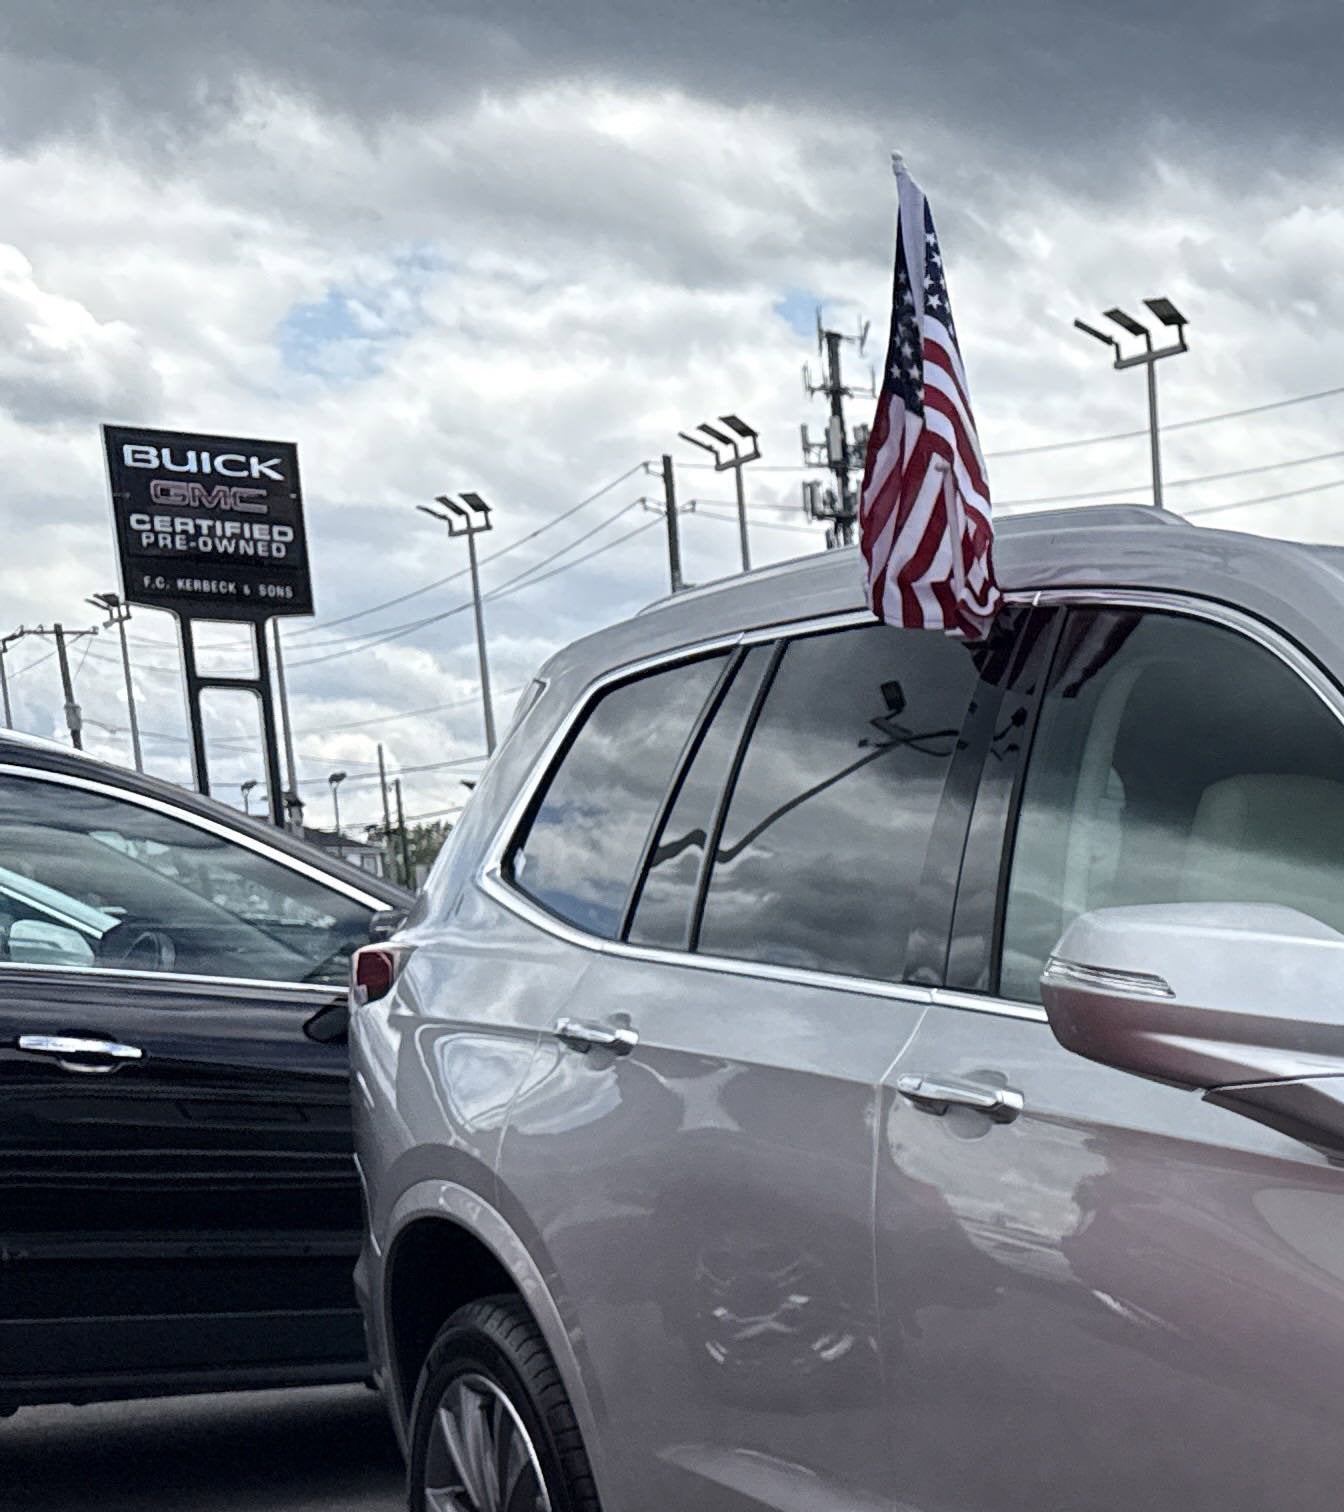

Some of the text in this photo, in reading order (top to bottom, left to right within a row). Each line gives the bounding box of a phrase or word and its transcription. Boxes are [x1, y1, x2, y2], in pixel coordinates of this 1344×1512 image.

[122, 444, 285, 481] BUICK
[150, 479, 268, 514] GMC
[129, 513, 294, 542] CERTIFIED
[141, 531, 287, 558] PRE-OWNED
[143, 575, 170, 589] F.C.
[176, 578, 237, 594] KERBECK
[258, 583, 293, 599] SONS
